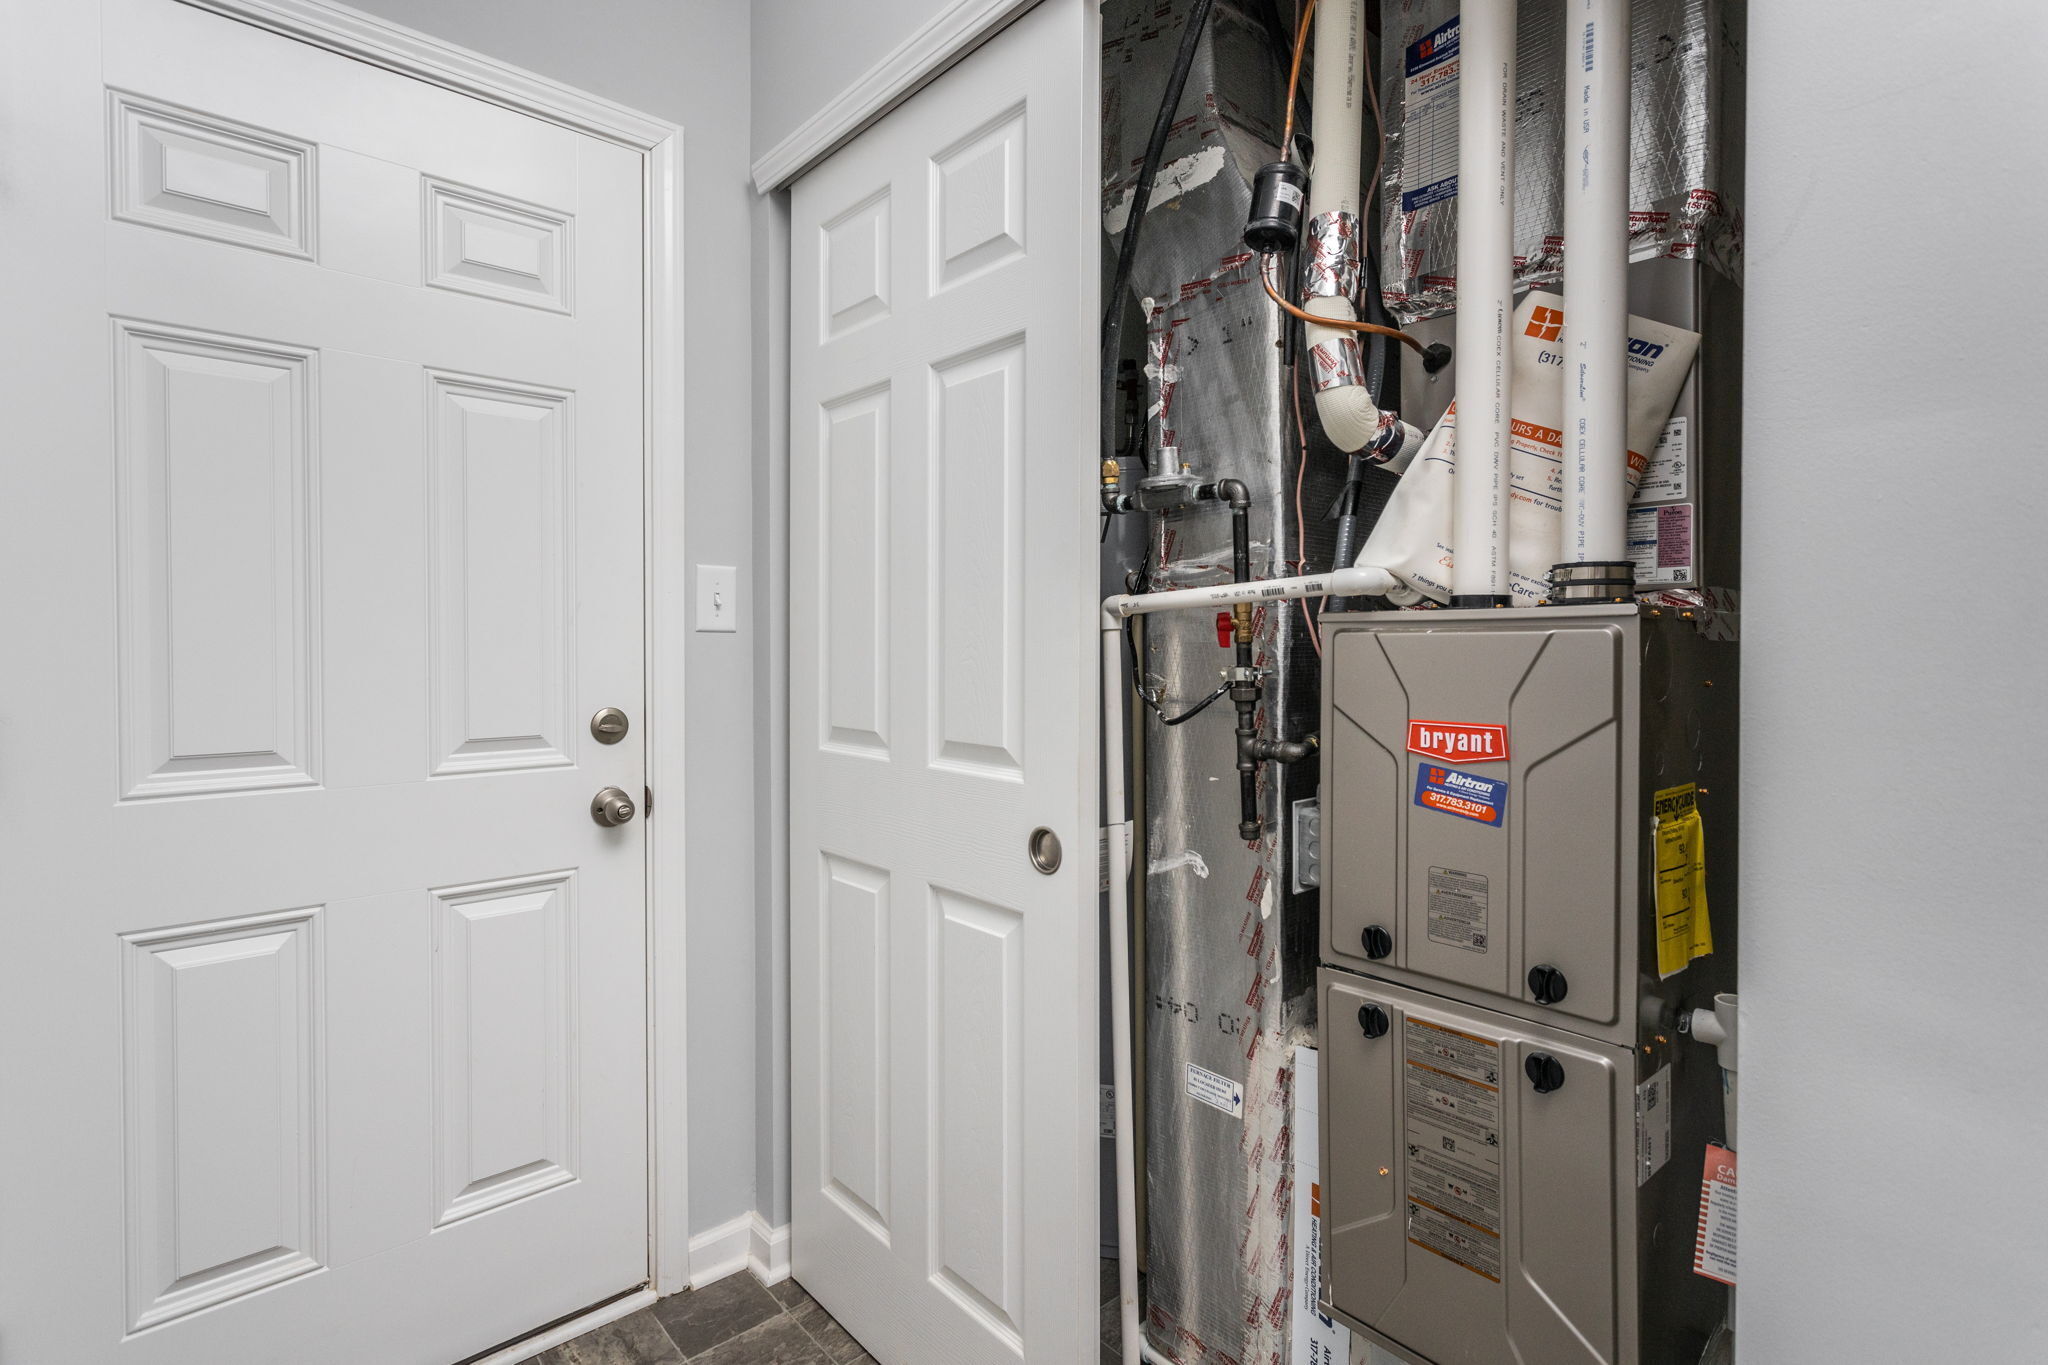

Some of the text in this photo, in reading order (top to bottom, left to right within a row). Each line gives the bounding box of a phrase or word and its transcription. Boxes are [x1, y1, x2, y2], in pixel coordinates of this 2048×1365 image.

[1427, 178, 1458, 193] ASK ABOU
[1628, 337, 1664, 360] on
[1535, 429, 1544, 440] A
[1540, 445, 1556, 456] Check
[1534, 498, 1543, 506] for
[1417, 575, 1436, 588] things
[1436, 584, 1447, 593] you
[1520, 574, 1530, 582] our
[1420, 727, 1493, 753] bryant
[1446, 772, 1494, 793] Airtron
[1430, 793, 1487, 814] 317.783.3101
[1717, 1164, 1736, 1179] CA
